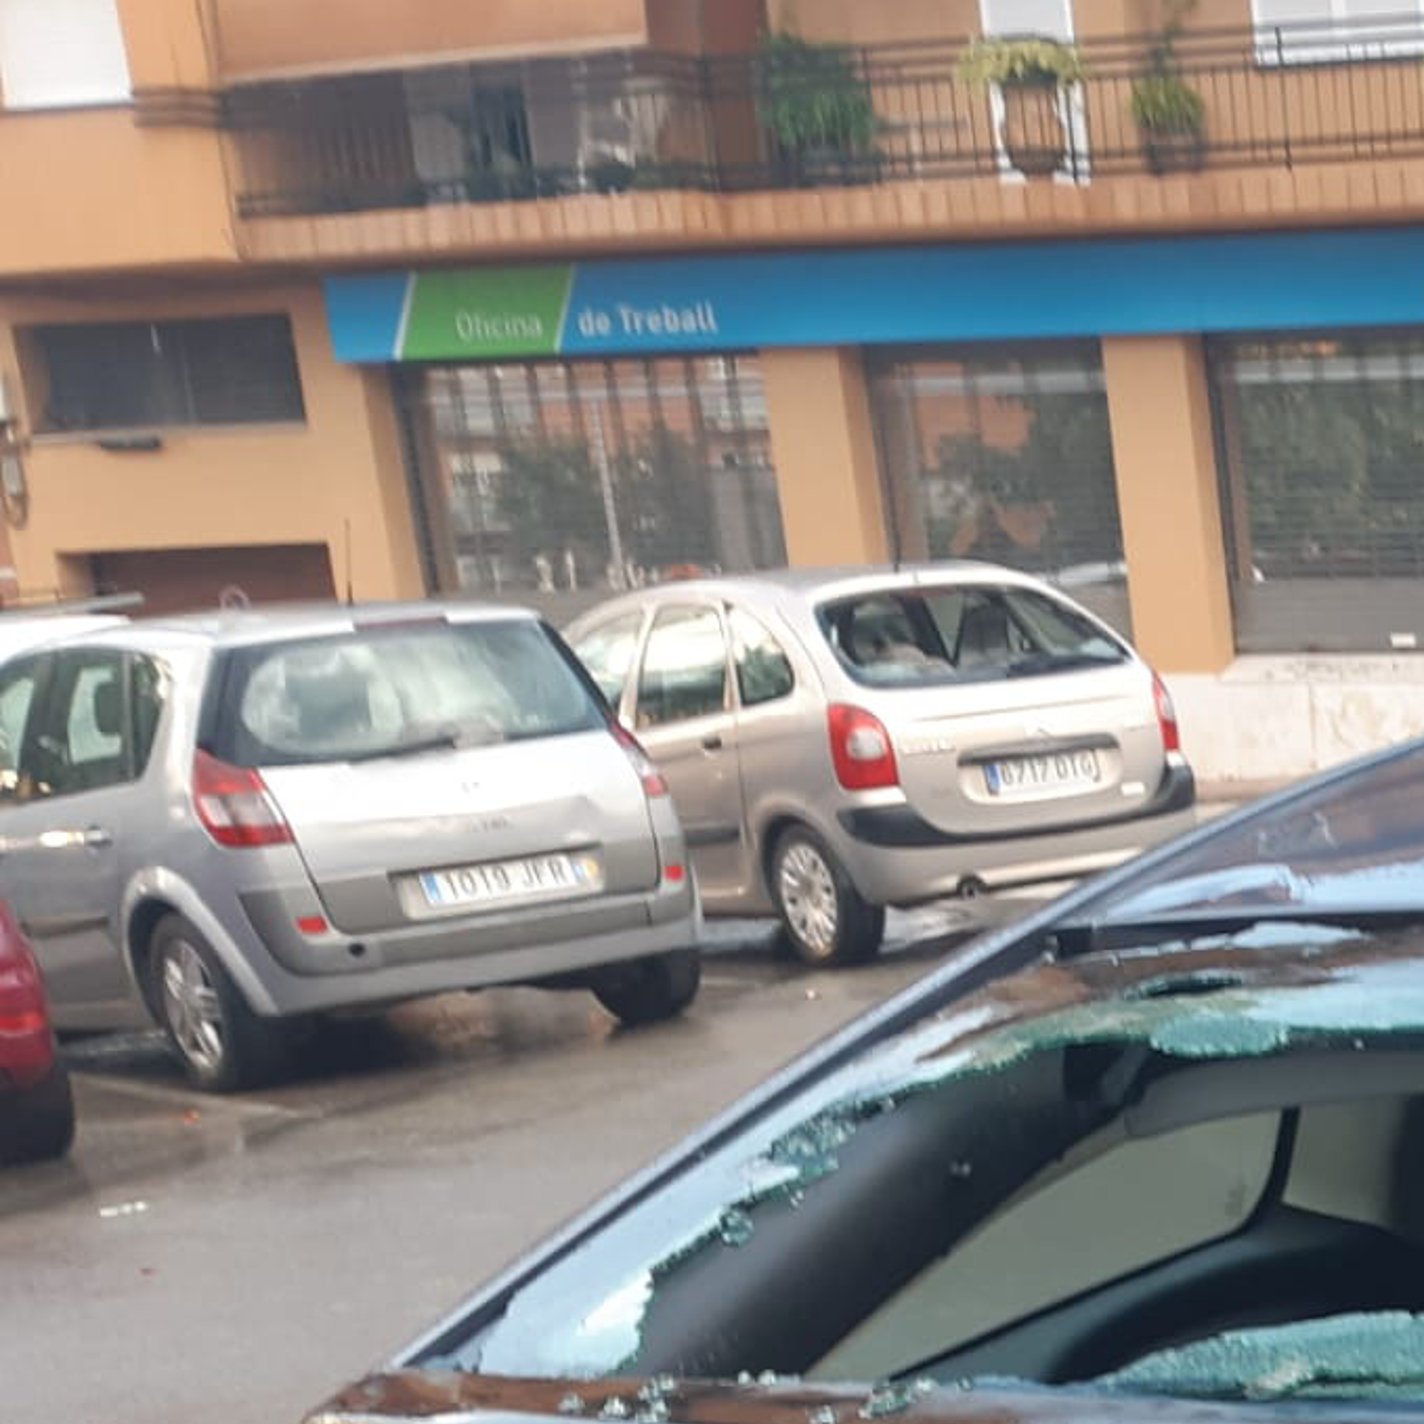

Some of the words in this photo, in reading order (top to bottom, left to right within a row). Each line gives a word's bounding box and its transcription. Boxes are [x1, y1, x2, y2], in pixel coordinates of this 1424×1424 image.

[455, 310, 544, 342] Oficina
[578, 307, 611, 337] de
[618, 300, 718, 336] Treball
